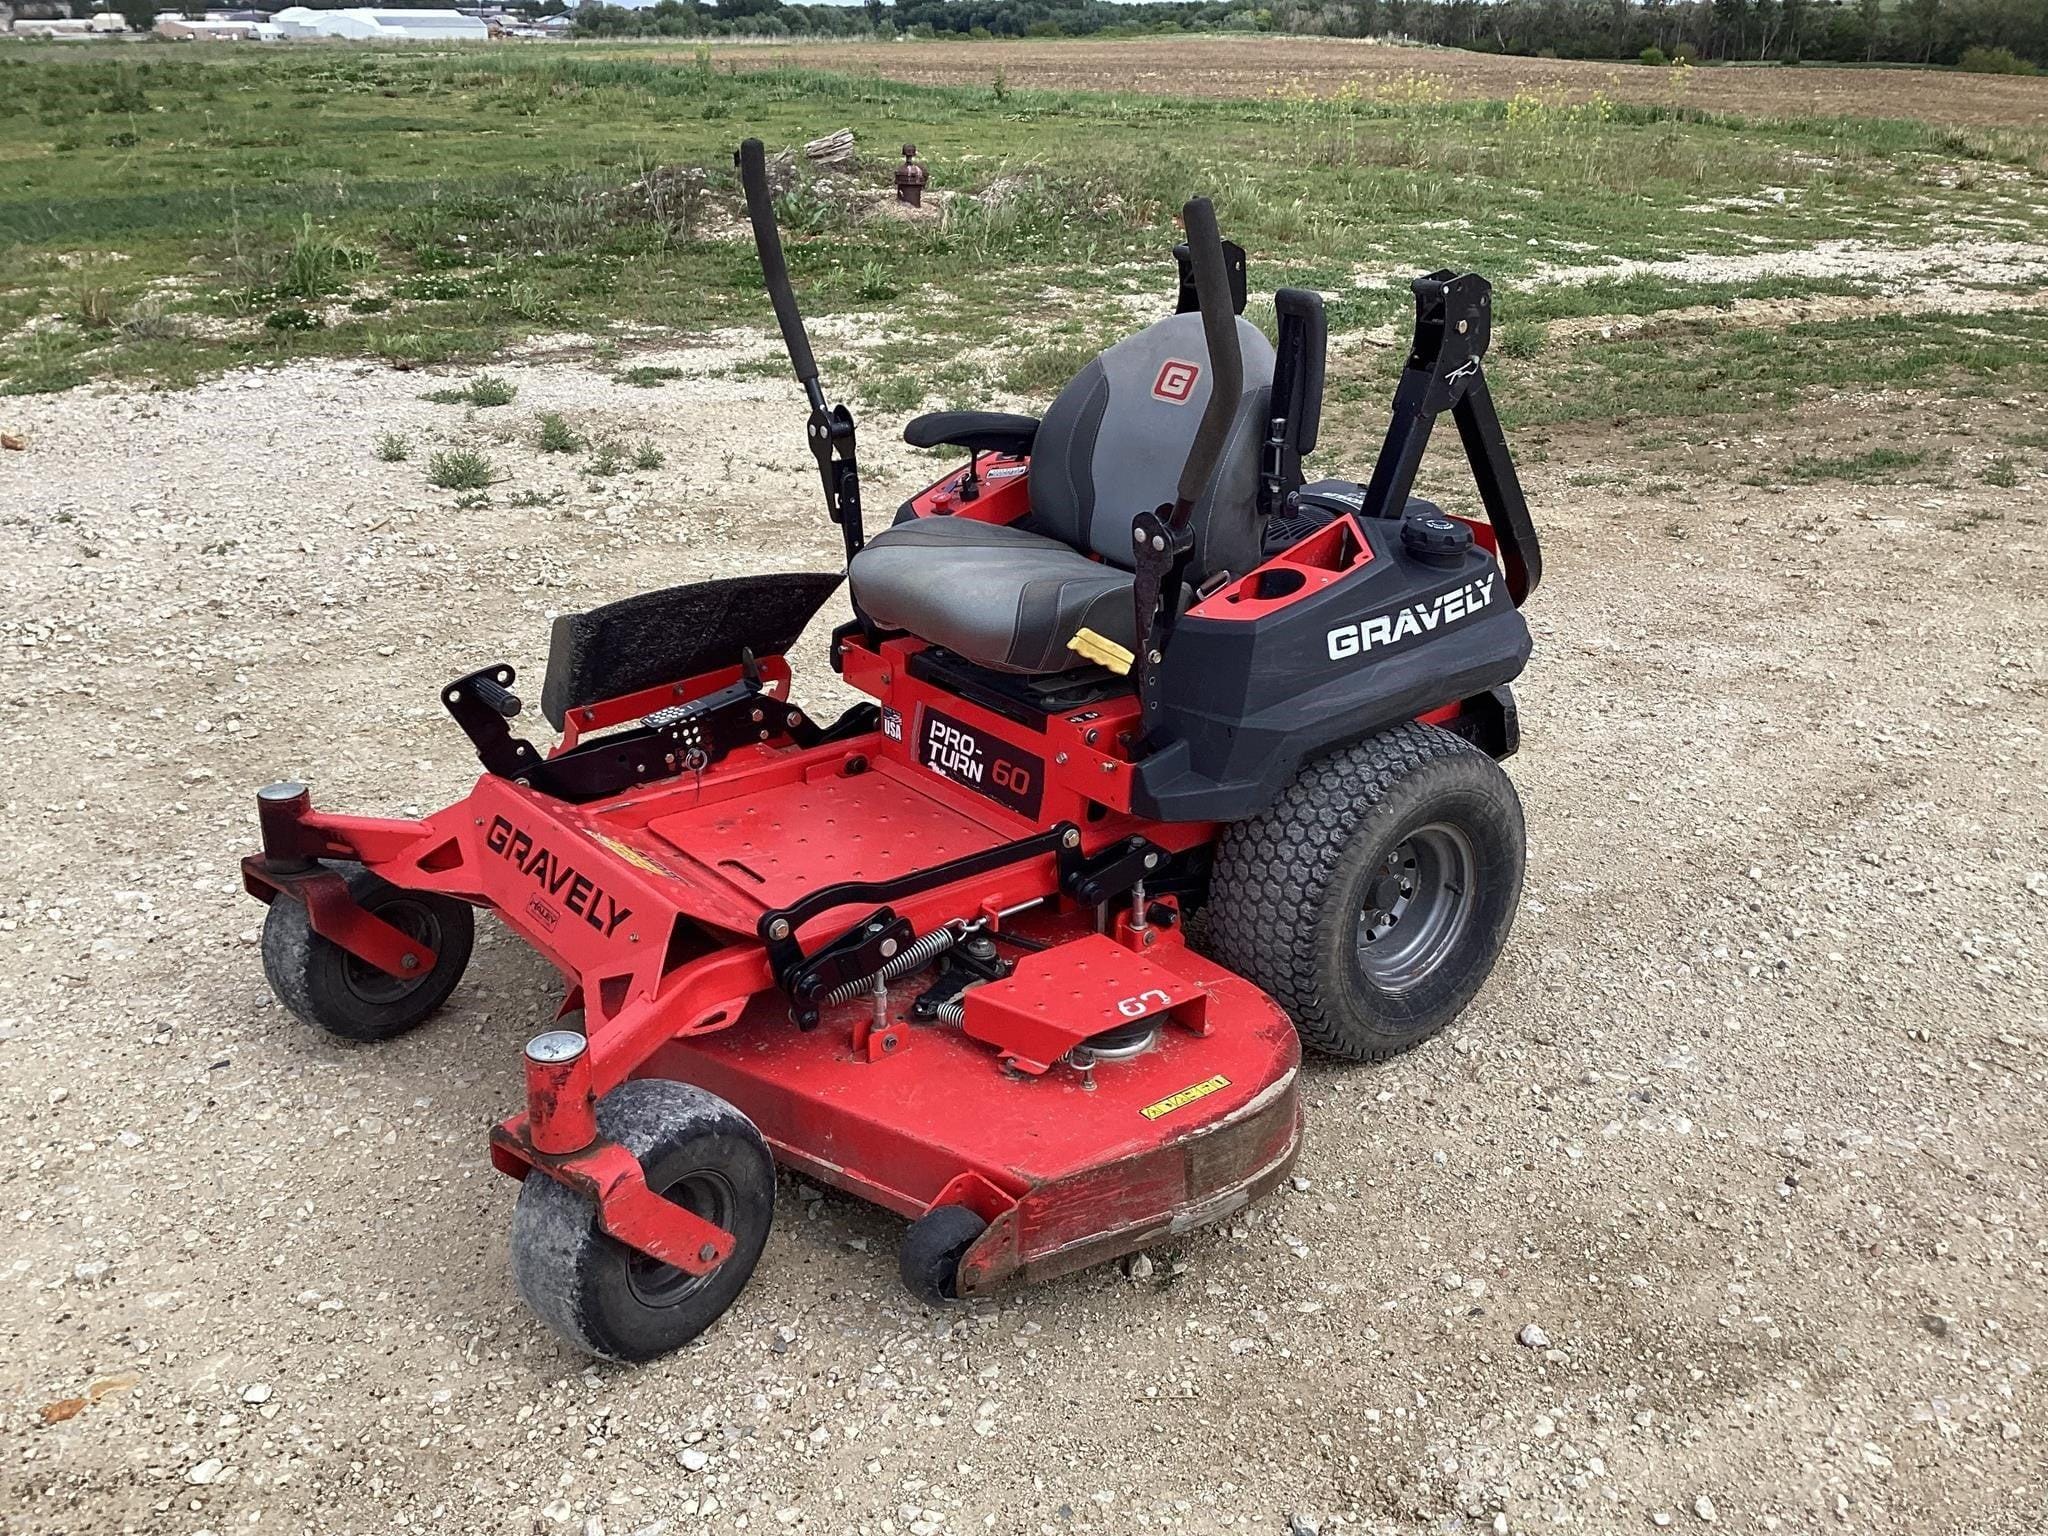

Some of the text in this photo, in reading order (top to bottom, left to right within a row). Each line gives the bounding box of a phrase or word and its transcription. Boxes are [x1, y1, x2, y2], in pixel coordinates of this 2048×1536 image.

[1327, 572, 1495, 661] GRAVELY
[884, 719, 902, 741] USA
[930, 720, 983, 757] PRO-
[929, 739, 984, 783] TURN
[991, 758, 1030, 796] 60
[487, 814, 633, 938] GRAVELY
